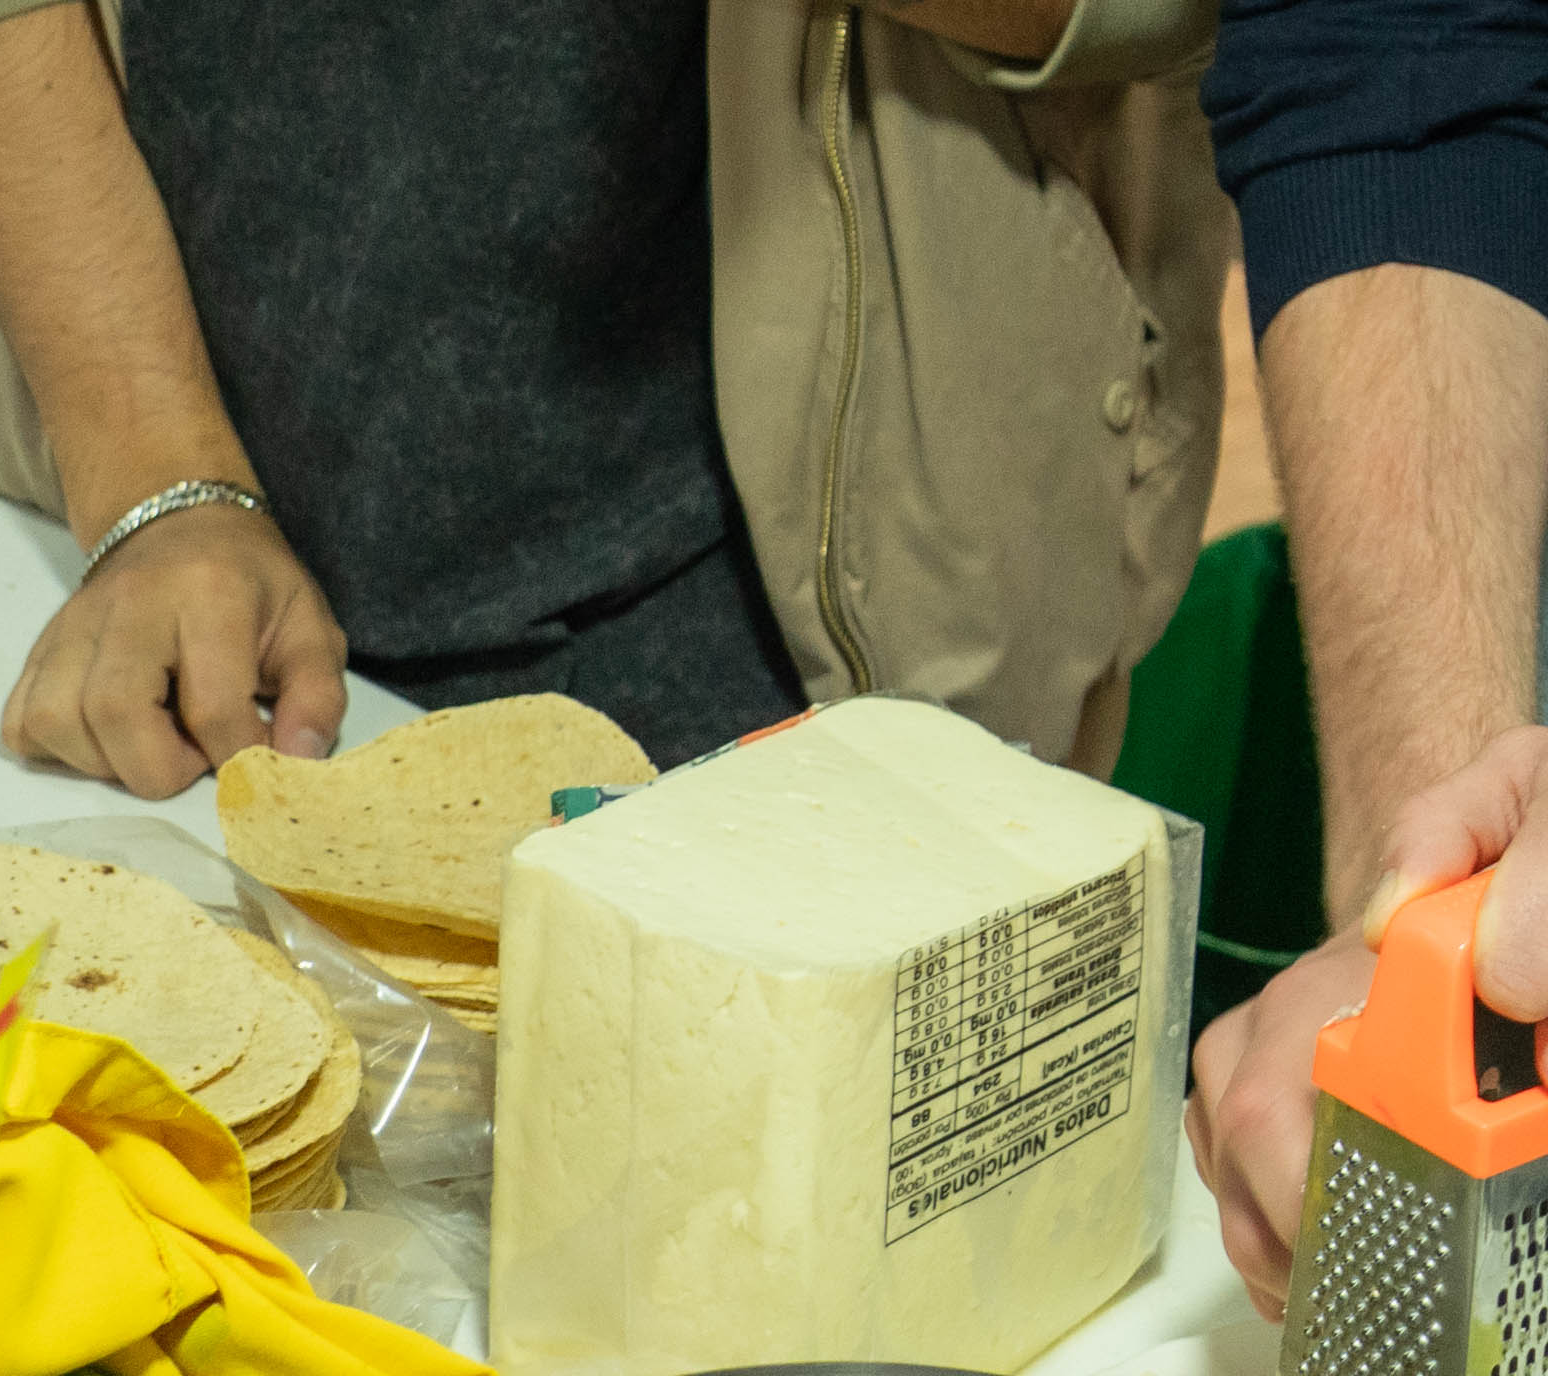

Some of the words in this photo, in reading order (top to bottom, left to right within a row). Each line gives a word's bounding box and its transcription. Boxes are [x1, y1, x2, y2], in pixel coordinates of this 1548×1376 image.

[979, 932, 988, 948] g
[978, 951, 987, 968] g
[1088, 947, 1121, 972] Grasa
[913, 966, 922, 982] g
[977, 972, 986, 988] g
[1053, 966, 1086, 988] trans
[1086, 964, 1120, 990] Grasa
[911, 984, 920, 1000] g
[977, 992, 986, 1008] g
[1030, 984, 1083, 1019] saturada
[911, 1004, 920, 1021] g
[970, 1012, 992, 1032] mg
[910, 1025, 920, 1042] g
[978, 1030, 987, 1047] g
[1082, 1019, 1132, 1056] Calorías
[904, 1045, 926, 1066] mg
[976, 1051, 986, 1066] g
[991, 1043, 1008, 1062] 24
[1090, 1047, 1130, 1076] Número
[910, 1064, 918, 1082] g
[1042, 1045, 1078, 1081] (Kcal)
[973, 1072, 1002, 1097] 294
[1075, 1071, 1088, 1085] de
[1076, 1067, 1126, 1102] Tamaño
[909, 1087, 918, 1099] g
[994, 1089, 1011, 1104] Por
[1024, 1079, 1074, 1113] porciones
[965, 1100, 989, 1120] 100g
[1004, 1104, 1022, 1124] por
[1051, 1094, 1072, 1116] por
[911, 1108, 931, 1128] 88
[1054, 1093, 1110, 1138] Datos
[933, 1120, 951, 1136] Por
[992, 1107, 1047, 1148] porción:
[893, 1128, 931, 1157] porción
[908, 1128, 1048, 1218] Nutricionales
[933, 1149, 975, 1178] tajada
[895, 1165, 914, 1184] 100
[890, 1172, 927, 1202] (30g)
